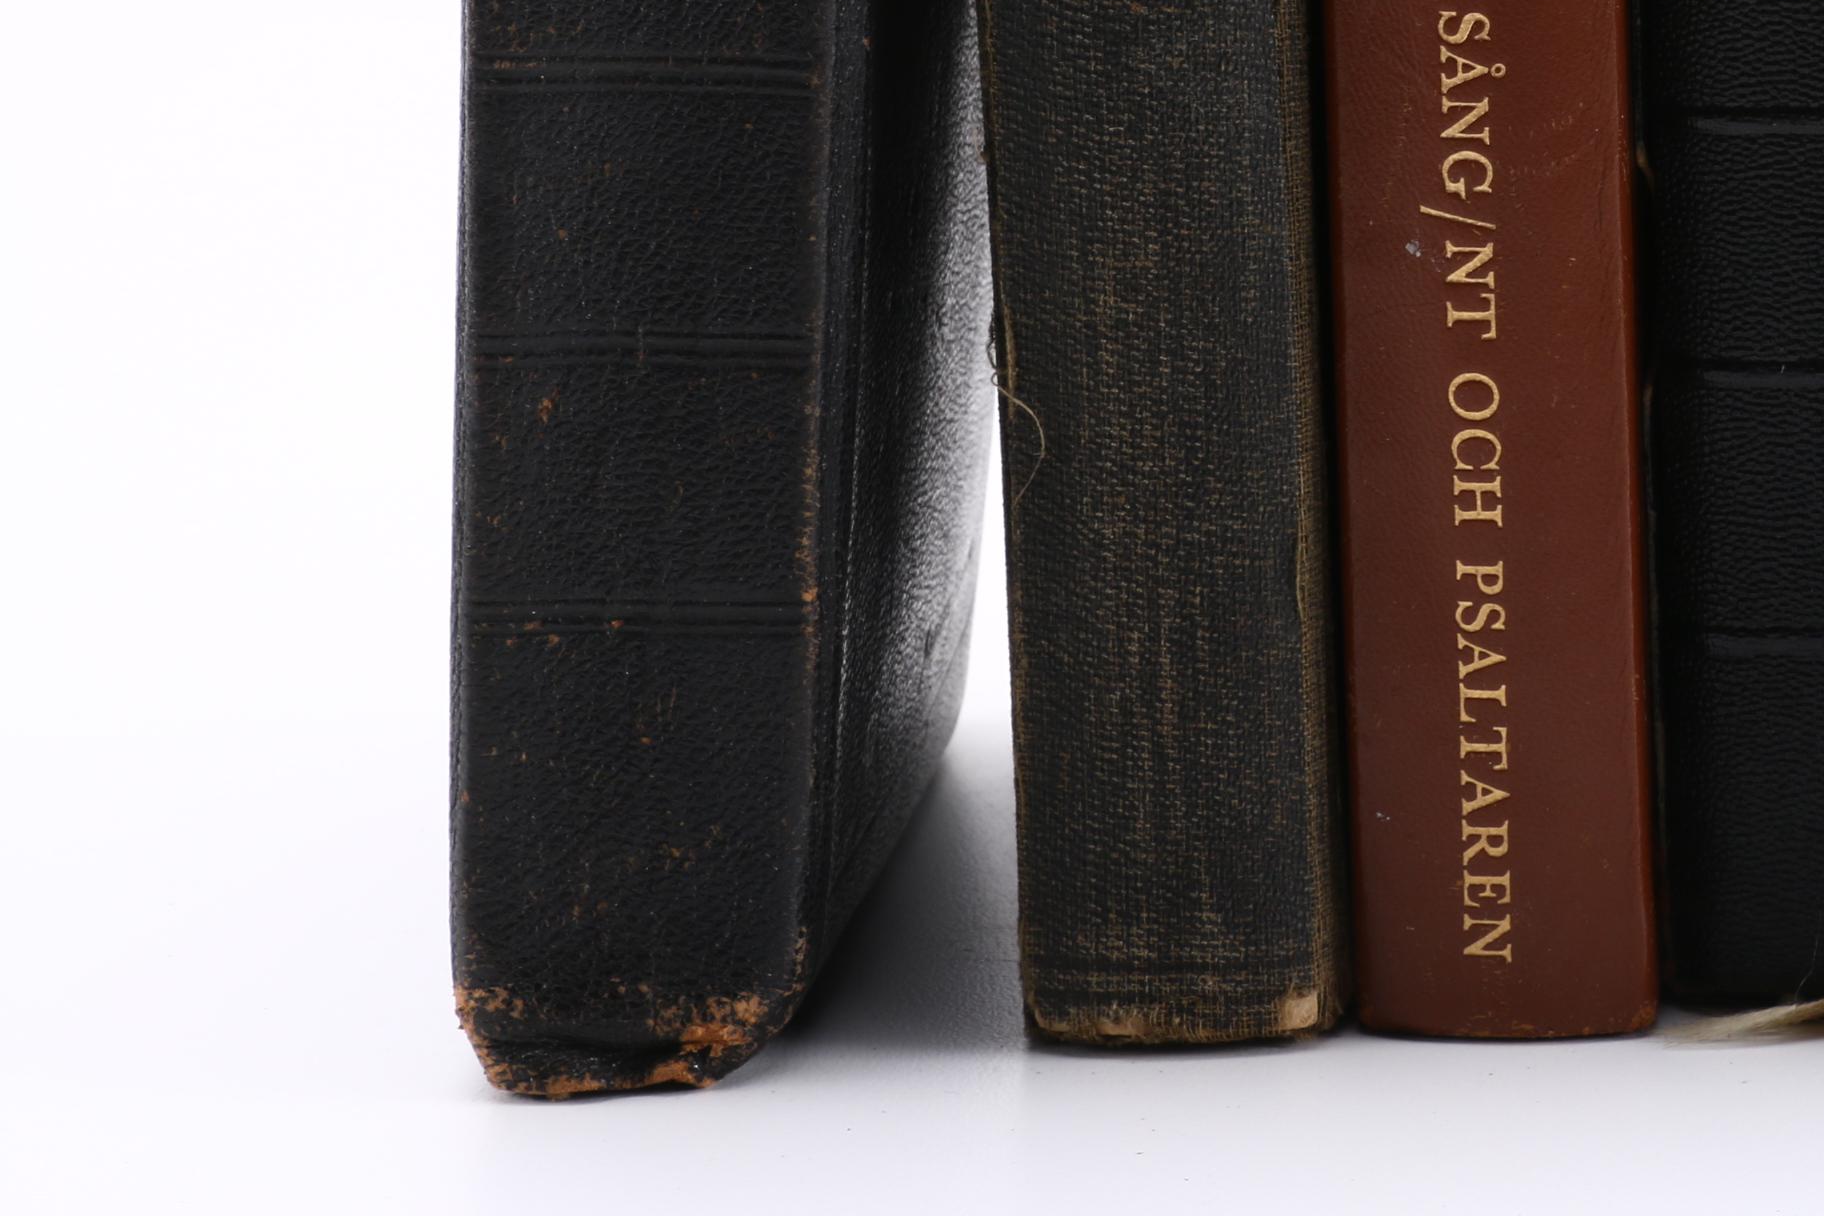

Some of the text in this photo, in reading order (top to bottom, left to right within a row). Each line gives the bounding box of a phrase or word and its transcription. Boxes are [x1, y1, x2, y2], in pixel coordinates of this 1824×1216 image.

[1419, 10, 1506, 340] SÅNG/NT
[1447, 372, 1504, 529] OCH
[1454, 559, 1513, 963] PSALTAREN
